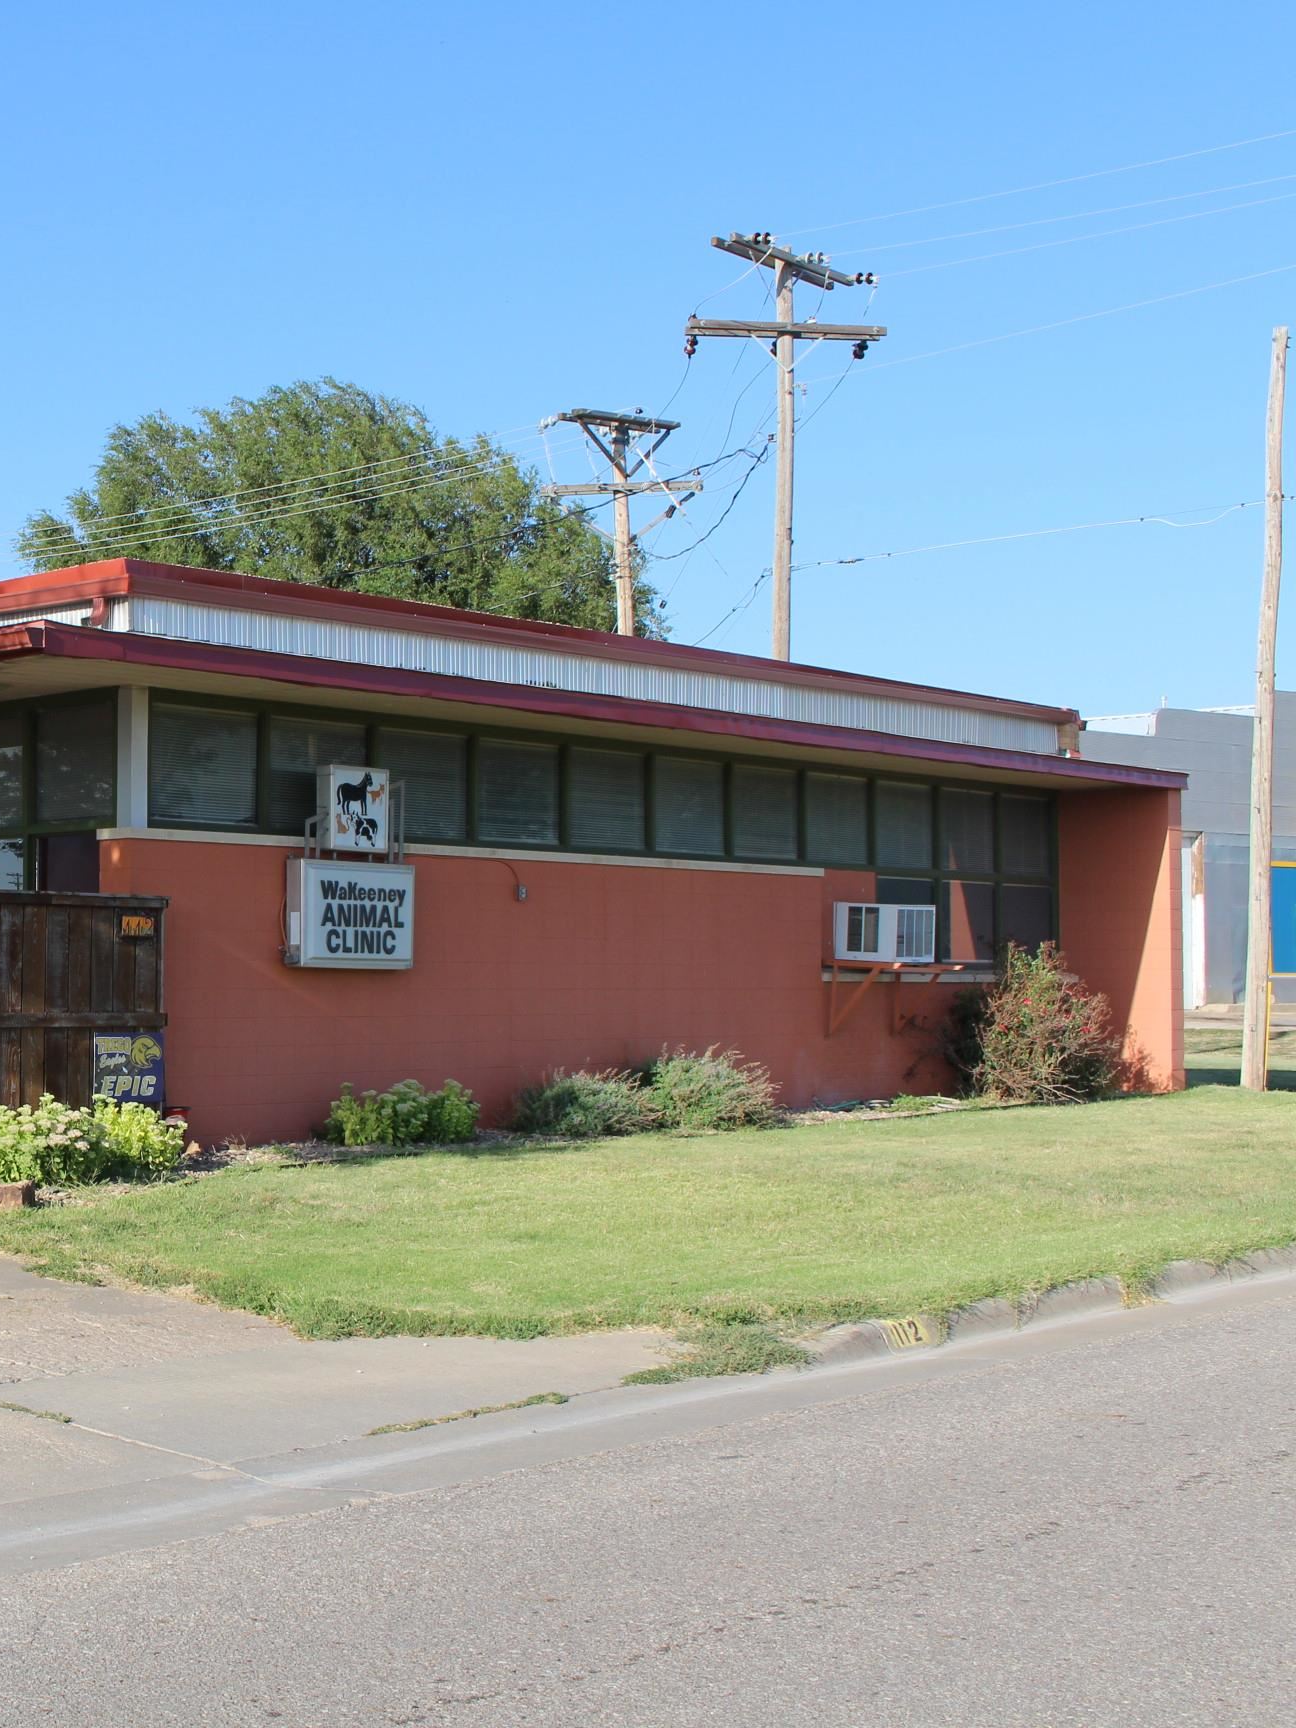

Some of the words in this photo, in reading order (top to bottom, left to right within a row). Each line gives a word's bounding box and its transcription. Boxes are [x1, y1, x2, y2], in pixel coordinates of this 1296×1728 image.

[320, 880, 406, 907] WaKeeney
[320, 902, 405, 928] ANIMAL
[326, 928, 396, 955] CLINIC
[100, 1075, 157, 1097] EPIC
